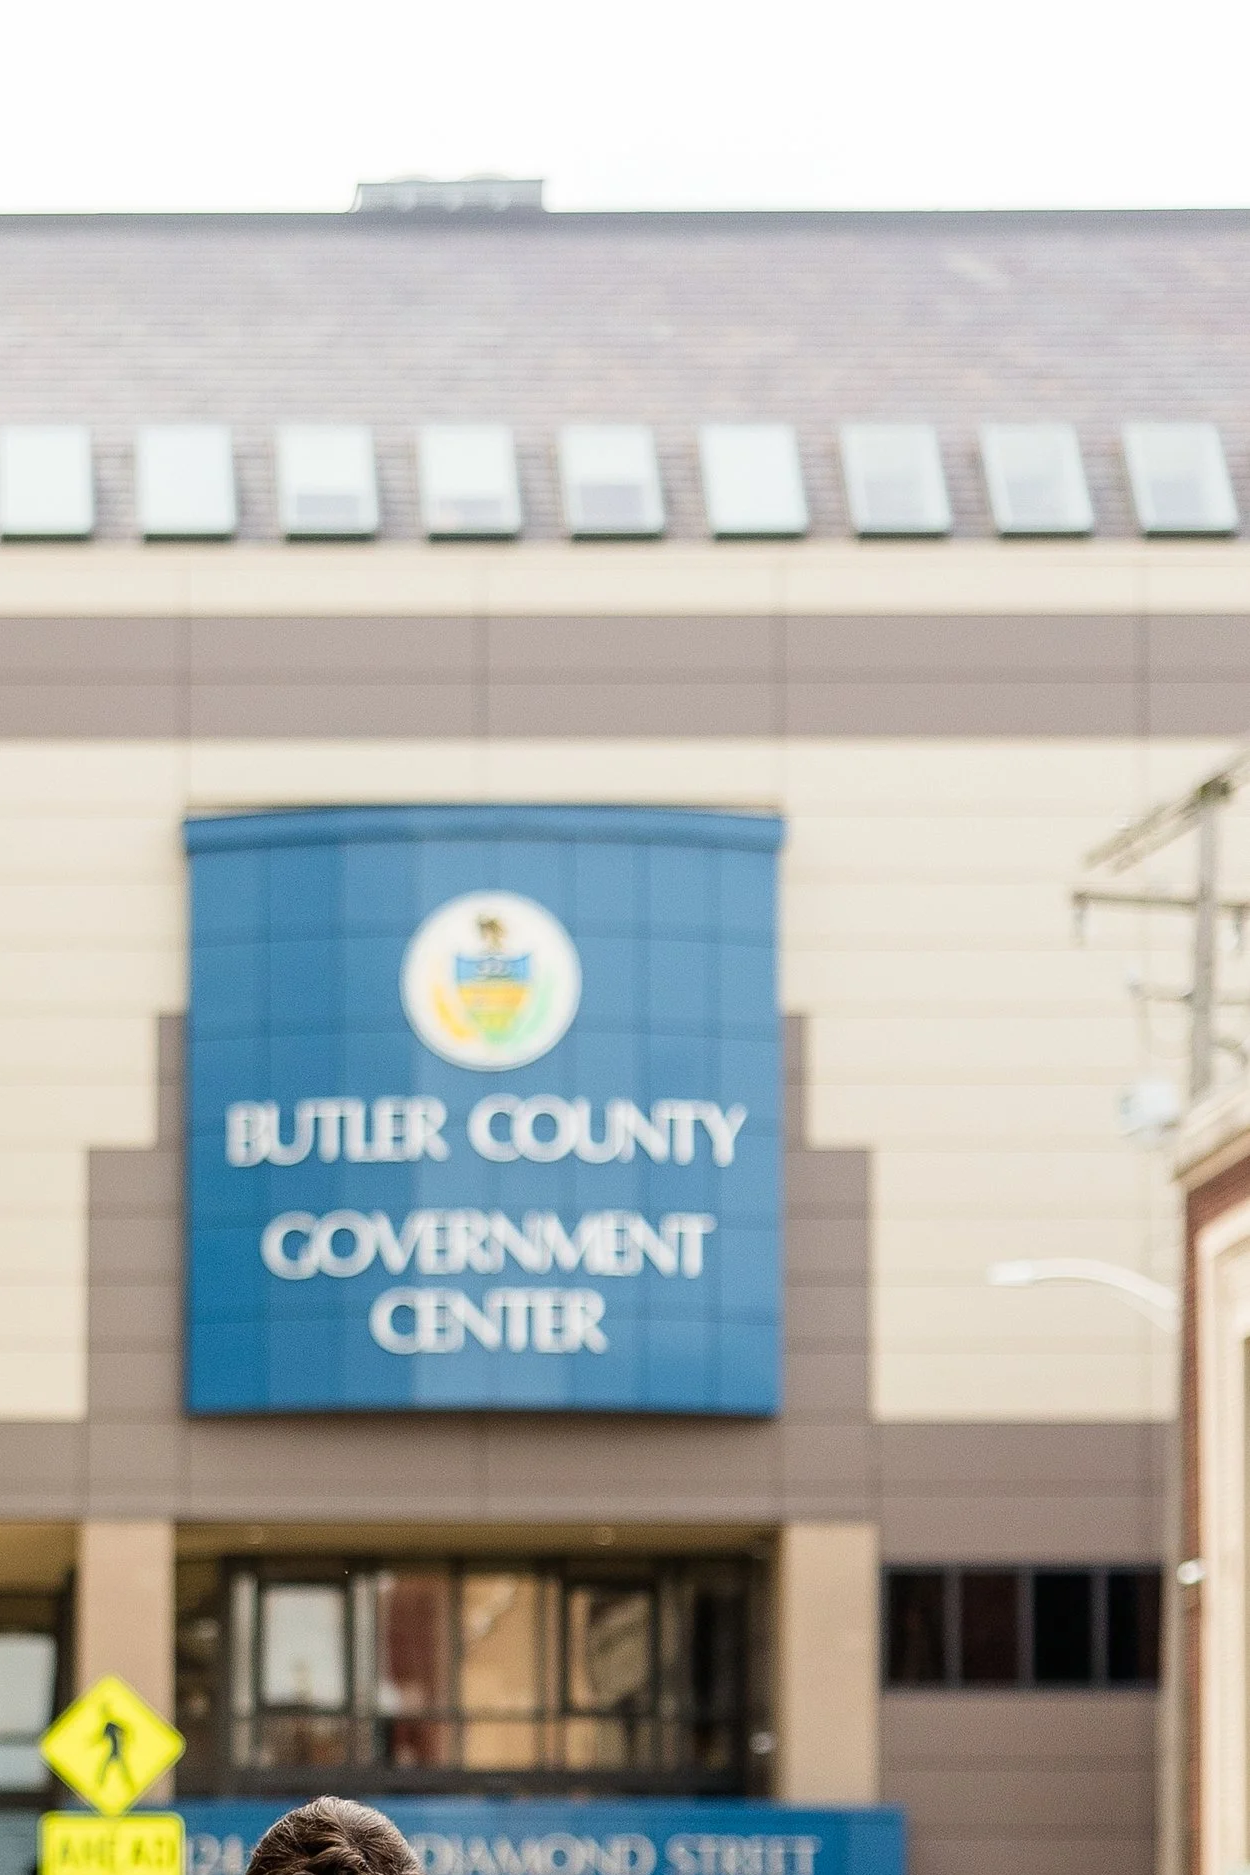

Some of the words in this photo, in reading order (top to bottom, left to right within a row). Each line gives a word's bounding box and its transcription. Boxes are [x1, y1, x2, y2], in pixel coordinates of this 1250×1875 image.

[225, 1095, 449, 1167] BUTLER
[467, 1093, 747, 1167] COUNTY
[261, 1209, 717, 1280] GOVERNMENT
[369, 1286, 609, 1355] CENTER
[58, 1836, 179, 1870] AHEAD
